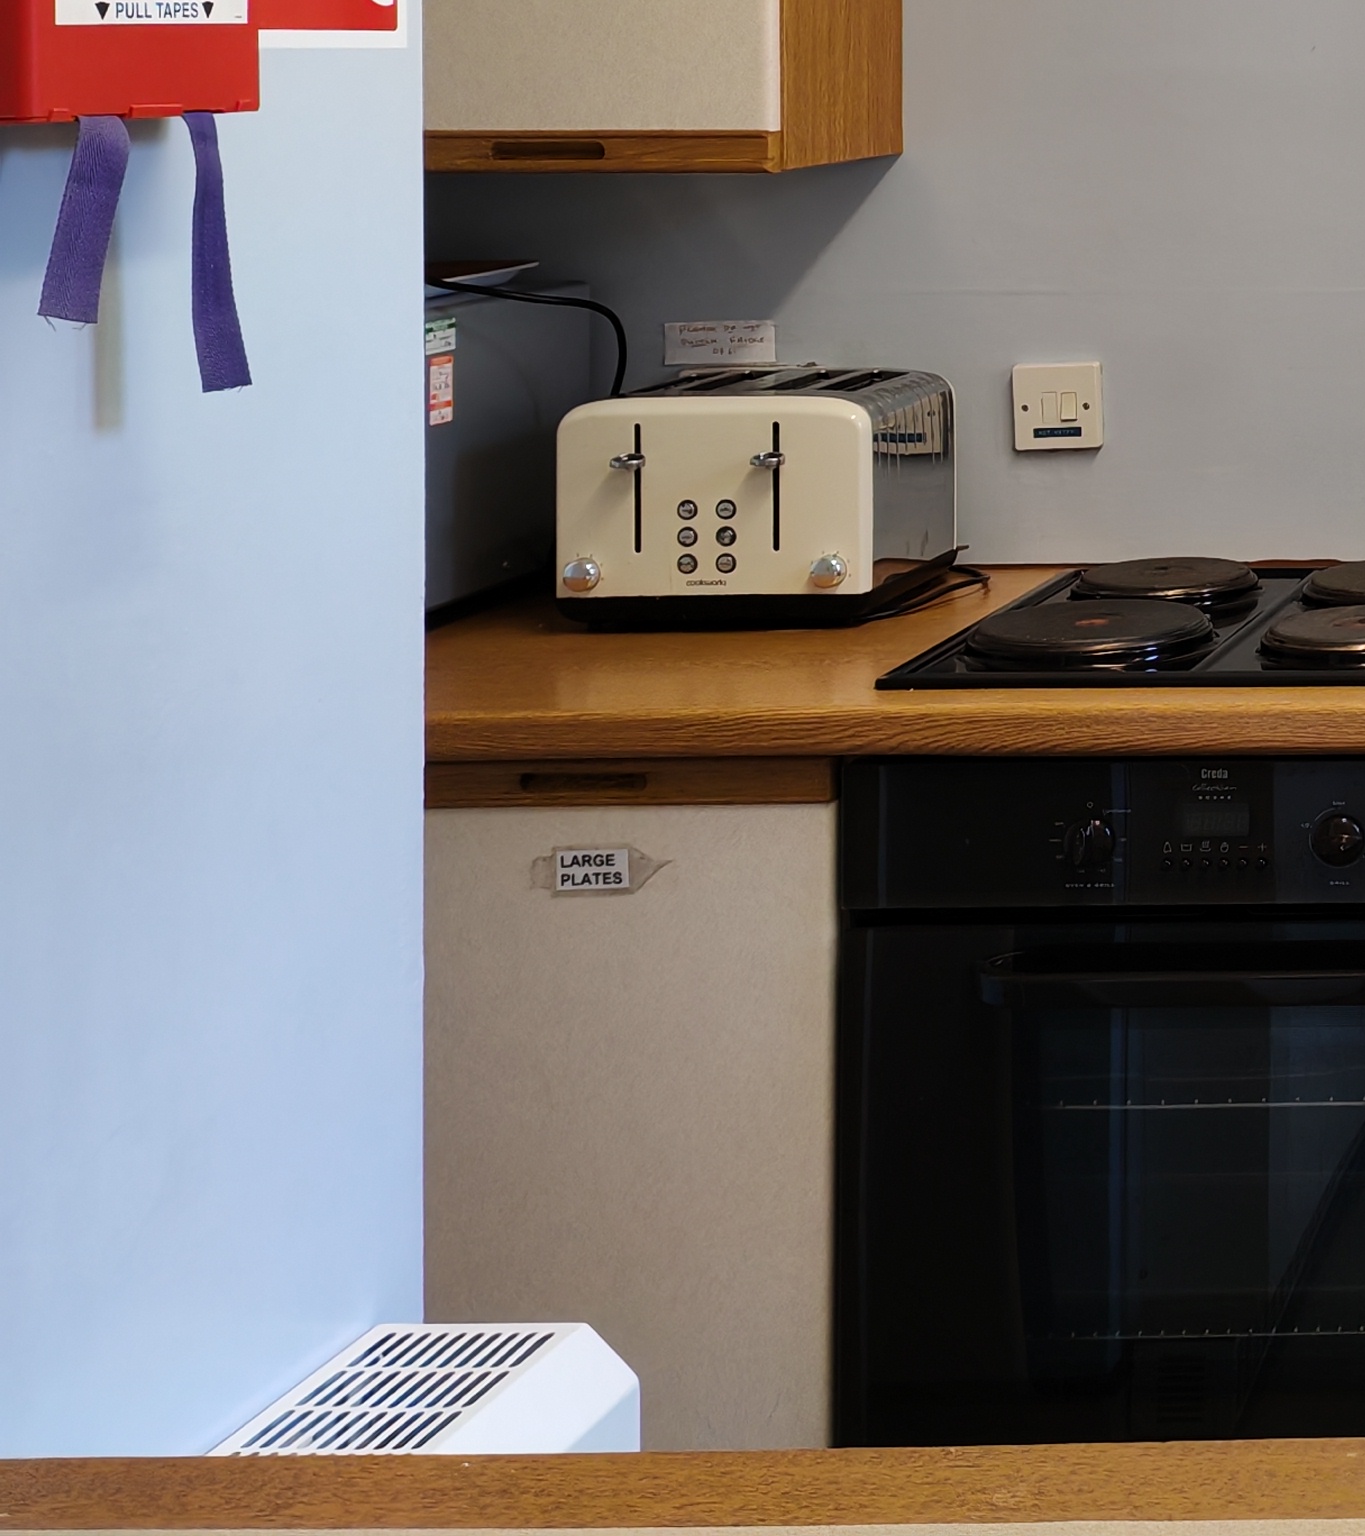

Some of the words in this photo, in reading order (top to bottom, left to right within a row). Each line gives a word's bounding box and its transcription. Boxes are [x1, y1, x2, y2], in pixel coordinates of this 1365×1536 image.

[116, 2, 152, 19] PULL
[155, 1, 199, 18] TAPES
[1200, 768, 1229, 779] Creda
[560, 853, 616, 869] LARGE
[560, 871, 623, 887] PLATES
